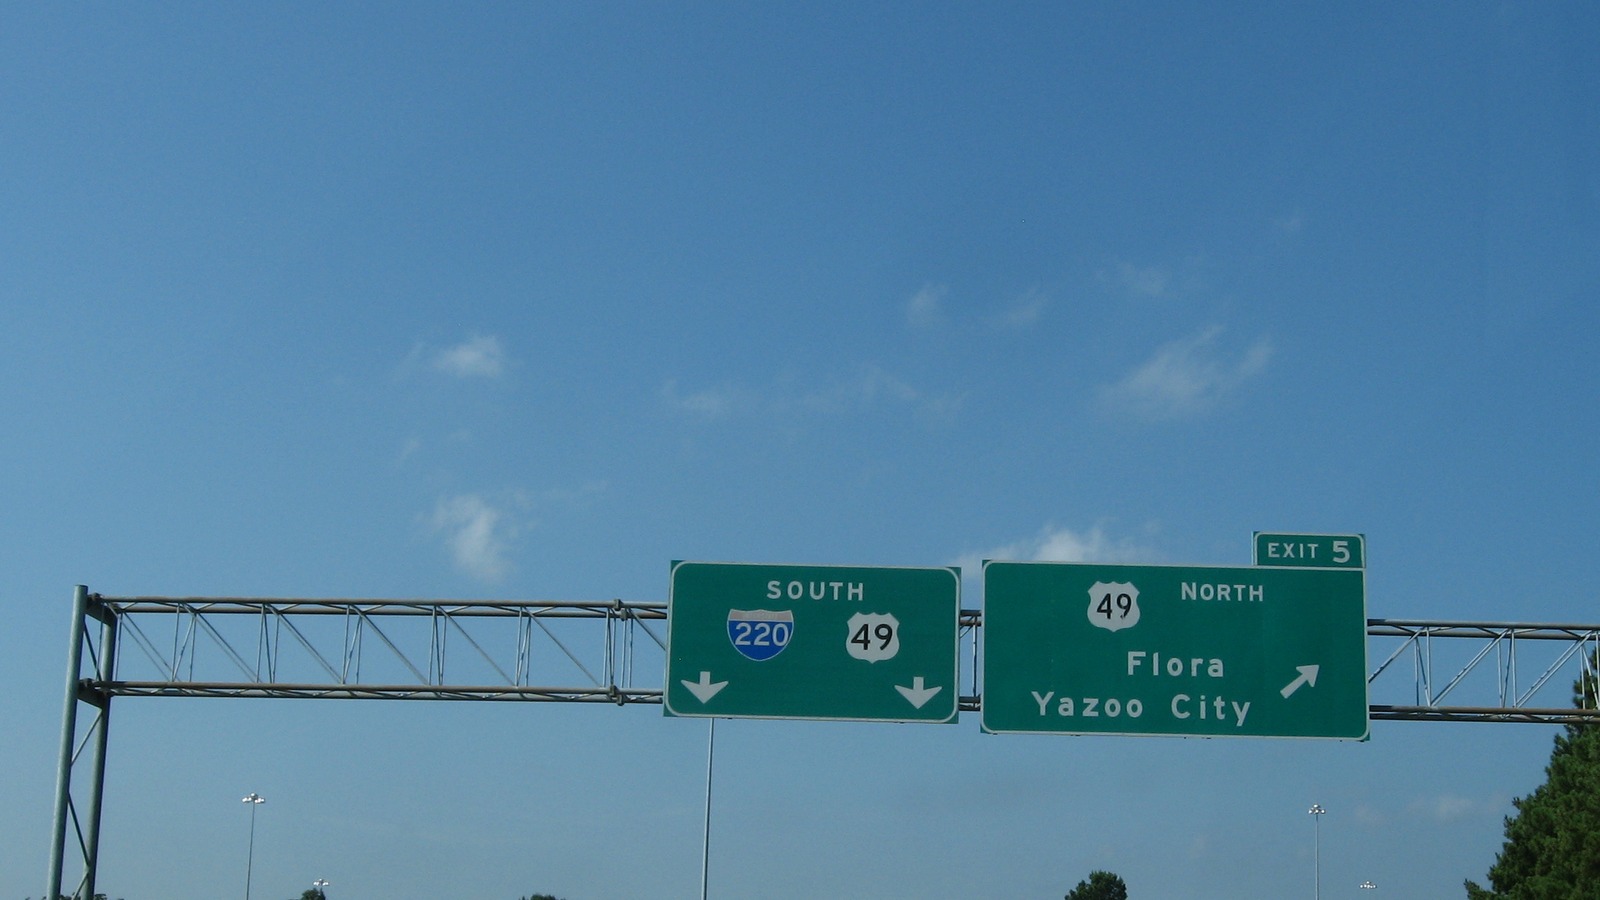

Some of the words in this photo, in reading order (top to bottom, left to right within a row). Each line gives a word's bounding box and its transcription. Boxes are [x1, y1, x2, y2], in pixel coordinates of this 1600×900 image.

[1267, 542, 1319, 559] EXIT
[1332, 540, 1351, 563] 5
[767, 580, 864, 601] SOUTH
[1180, 582, 1265, 602] NORTH
[1095, 592, 1133, 620] 49
[734, 622, 790, 646] 220
[851, 623, 893, 651] 49
[1127, 651, 1224, 677] Flora
[1031, 691, 1143, 719] Yazoo
[1171, 694, 1251, 727] City
